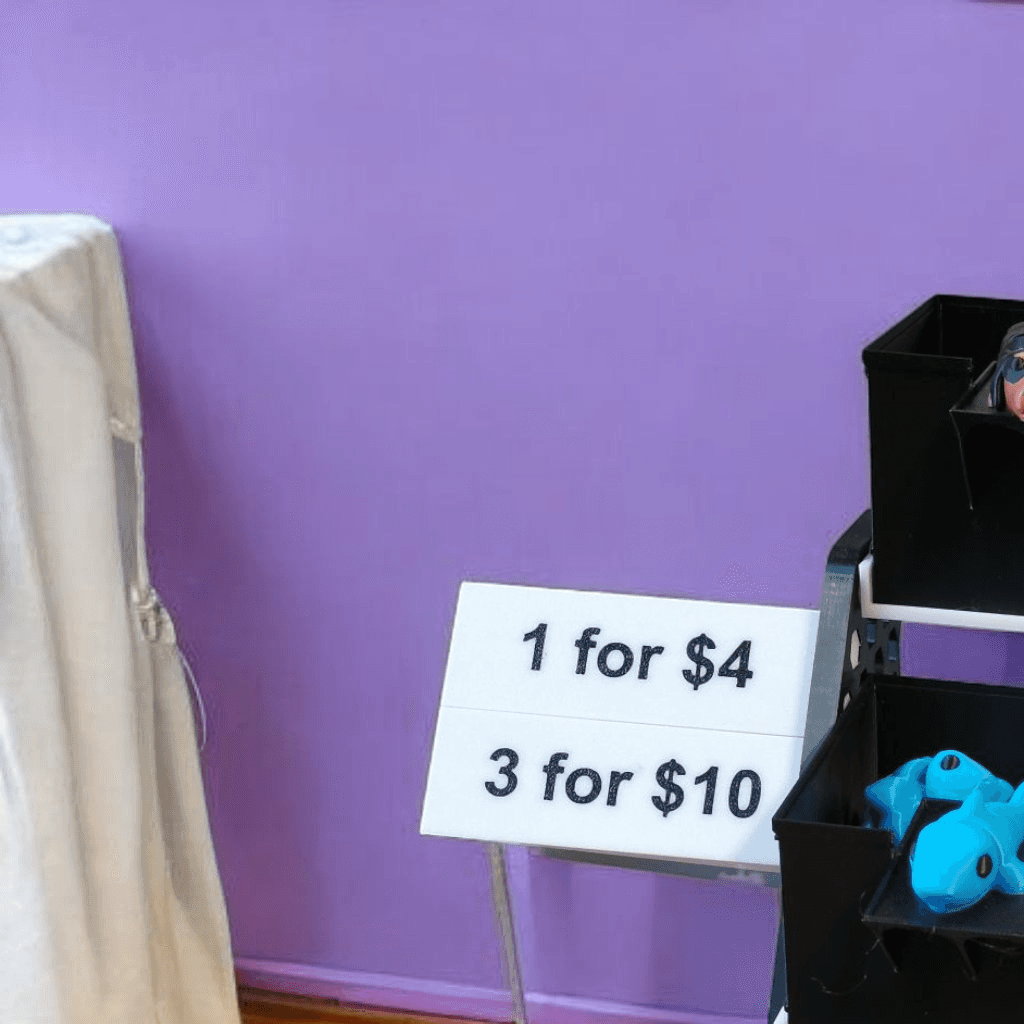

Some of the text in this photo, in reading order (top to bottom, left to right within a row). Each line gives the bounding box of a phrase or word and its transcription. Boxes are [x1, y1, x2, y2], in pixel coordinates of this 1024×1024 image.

[522, 622, 754, 691] 1 for $4
[484, 747, 762, 819] 3 for $10
